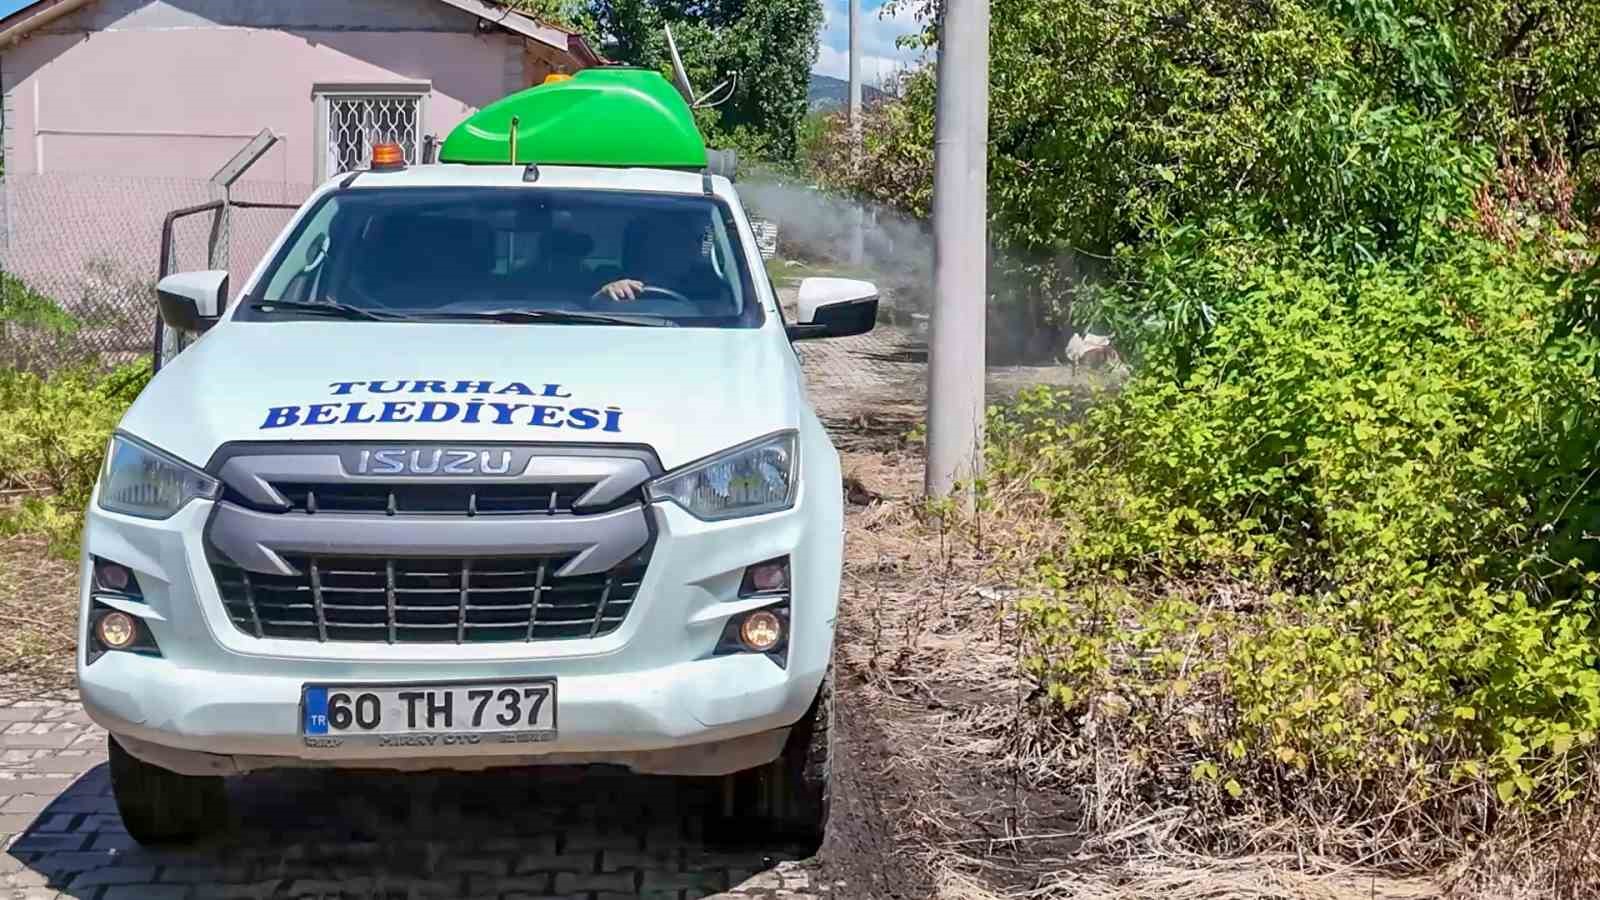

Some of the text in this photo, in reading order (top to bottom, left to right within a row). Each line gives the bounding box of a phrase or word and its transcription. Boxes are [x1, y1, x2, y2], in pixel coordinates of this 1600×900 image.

[329, 380, 572, 398] TURHAL
[259, 398, 623, 433] BELEDİYESİ
[359, 450, 512, 474] ISUZU
[311, 714, 326, 727] TR
[328, 688, 549, 730] 60 TH 737
